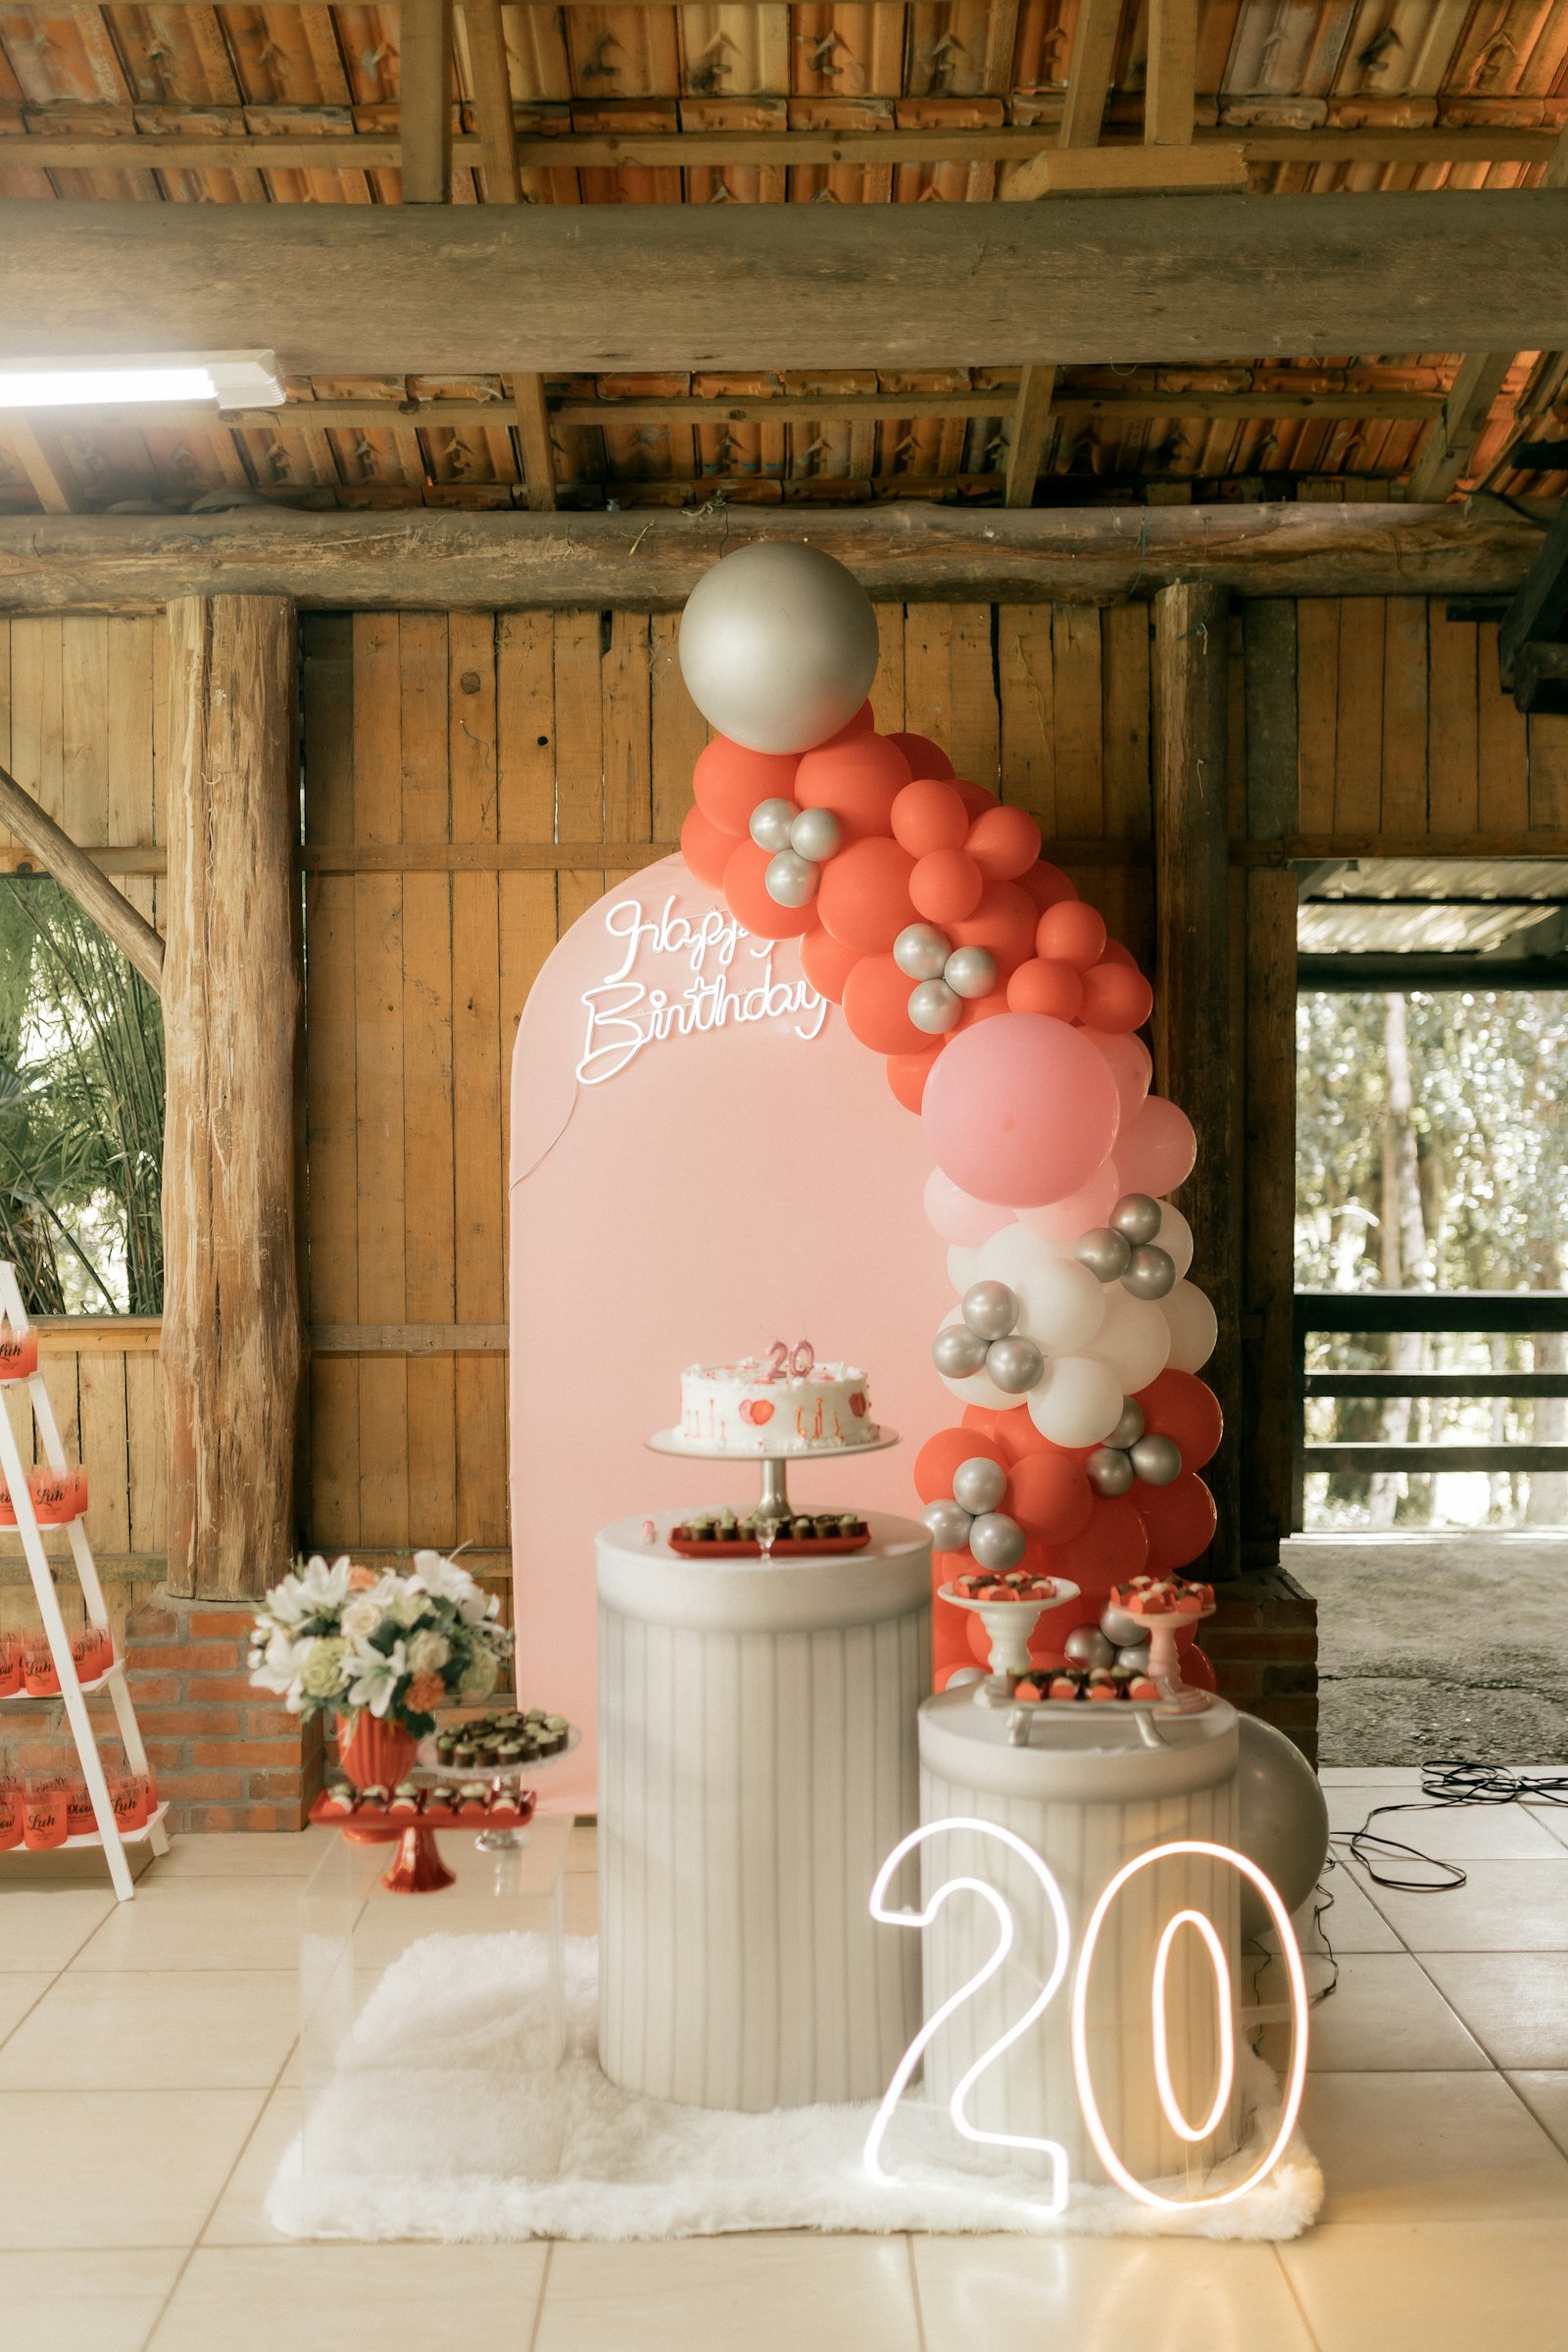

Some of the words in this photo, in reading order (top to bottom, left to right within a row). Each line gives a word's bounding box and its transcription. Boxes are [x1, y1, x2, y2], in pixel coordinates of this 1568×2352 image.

[575, 963, 830, 1086] Birthday
[765, 1340, 815, 1379] 20
[35, 1488, 65, 1507] Luh
[24, 1660, 53, 1680] Luh
[27, 1814, 56, 1833] Luh
[863, 1816, 1310, 2215] 20
